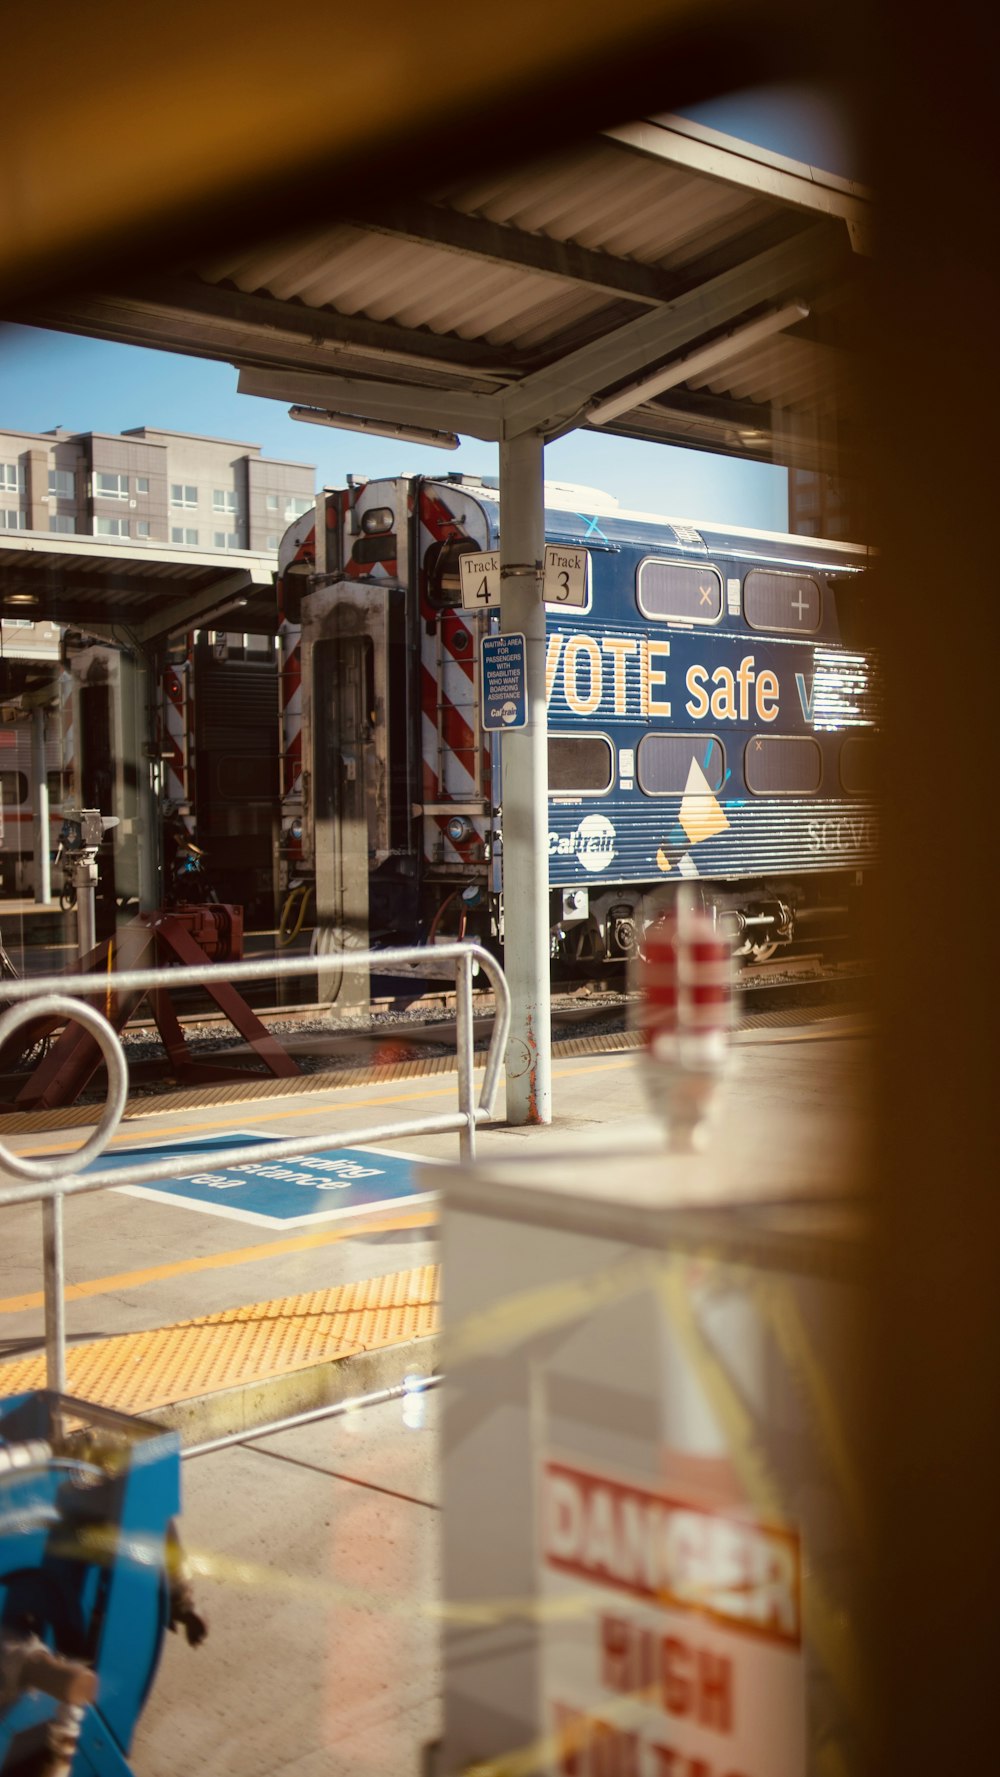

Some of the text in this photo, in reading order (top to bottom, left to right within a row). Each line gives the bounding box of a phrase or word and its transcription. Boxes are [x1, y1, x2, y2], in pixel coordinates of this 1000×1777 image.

[465, 558, 498, 573] Track
[549, 552, 581, 569] Track
[476, 575, 491, 604] 4
[556, 571, 570, 601] 3
[484, 638, 522, 648] WAITING AREA
[486, 654, 521, 663] PASSENGERS
[487, 669, 520, 678] DISABILITIES
[488, 692, 520, 700] ASSISTANCE
[490, 684, 518, 693] BOARDING
[685, 655, 780, 722] safe
[547, 831, 615, 854] Caltrain
[226, 1163, 352, 1190] stance
[276, 1155, 386, 1178] rding
[172, 1173, 247, 1189] rea
[549, 1474, 795, 1634] DANGER
[600, 1611, 735, 1738] HIGH
